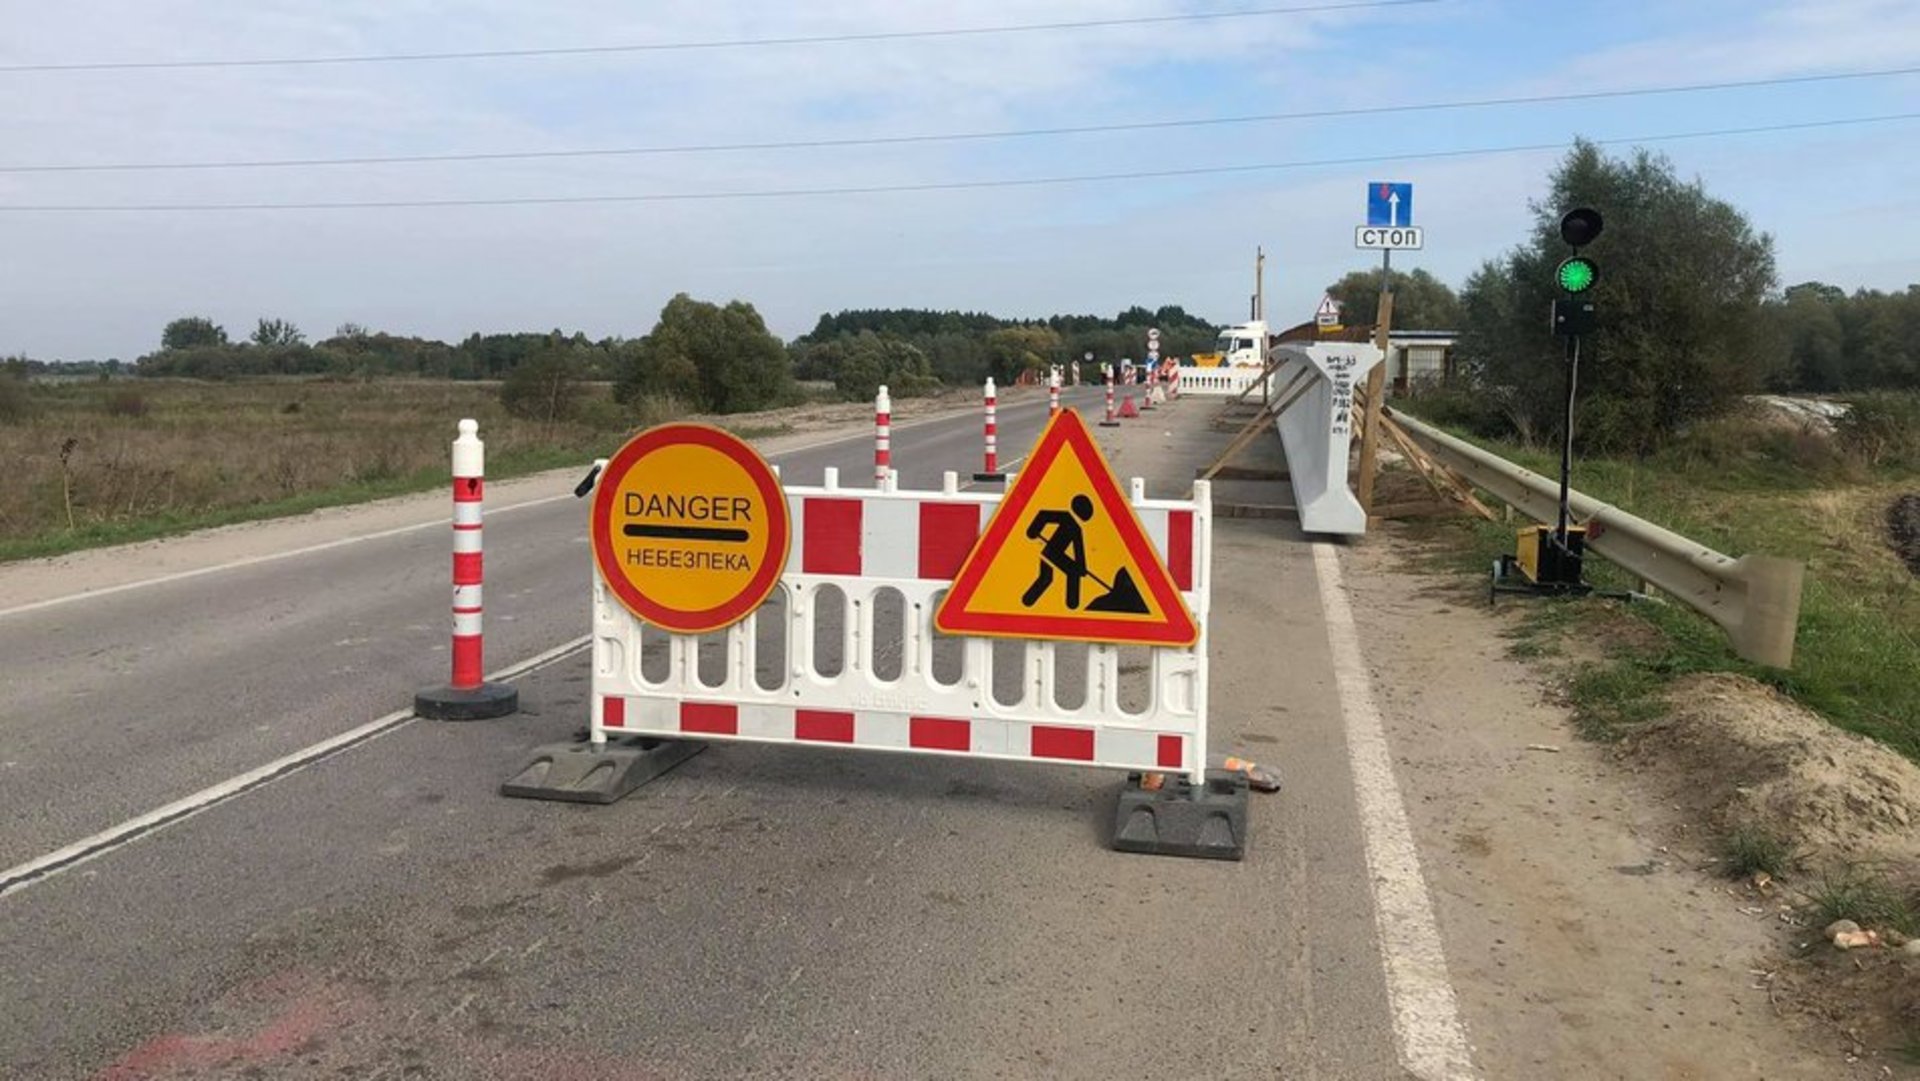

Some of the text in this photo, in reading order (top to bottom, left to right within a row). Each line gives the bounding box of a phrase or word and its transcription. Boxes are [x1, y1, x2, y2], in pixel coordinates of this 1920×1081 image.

[1362, 229, 1416, 245] СТОП
[624, 492, 751, 521] DANGER
[626, 548, 750, 571] НЕБЕЗПЕКА
